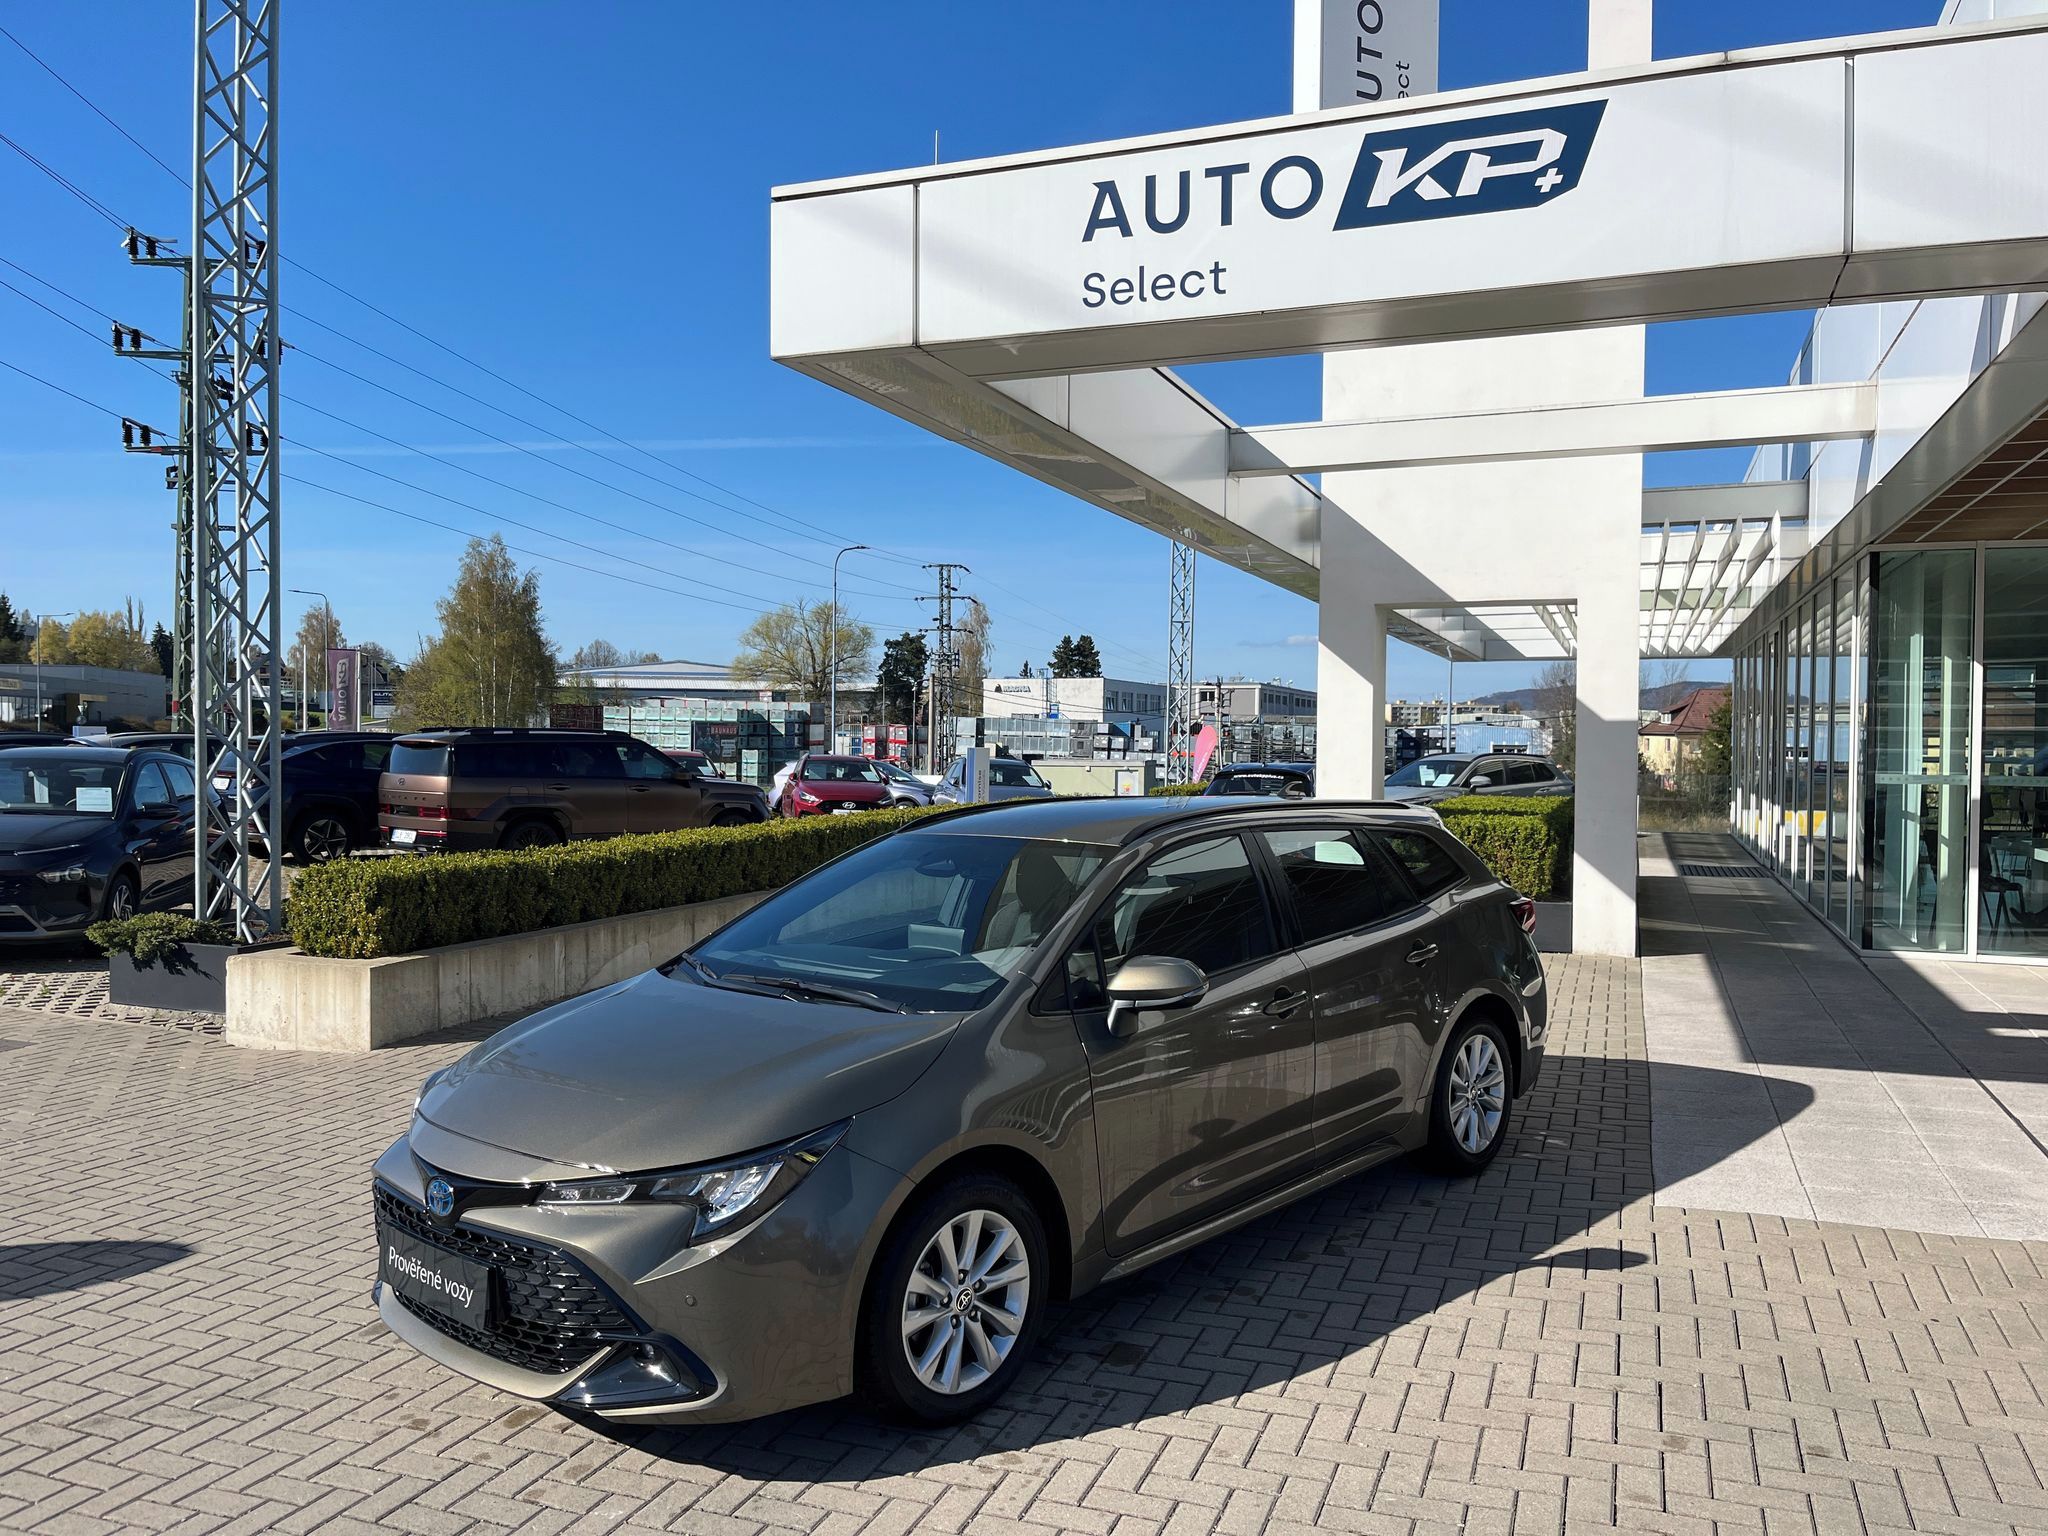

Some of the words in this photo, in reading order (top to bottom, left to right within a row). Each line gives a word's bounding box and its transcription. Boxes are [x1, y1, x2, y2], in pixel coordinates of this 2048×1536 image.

[1082, 155, 1324, 242] AUTO
[1082, 261, 1227, 308] Select
[389, 1246, 442, 1290] Prověřené
[444, 1278, 474, 1308] vozy
